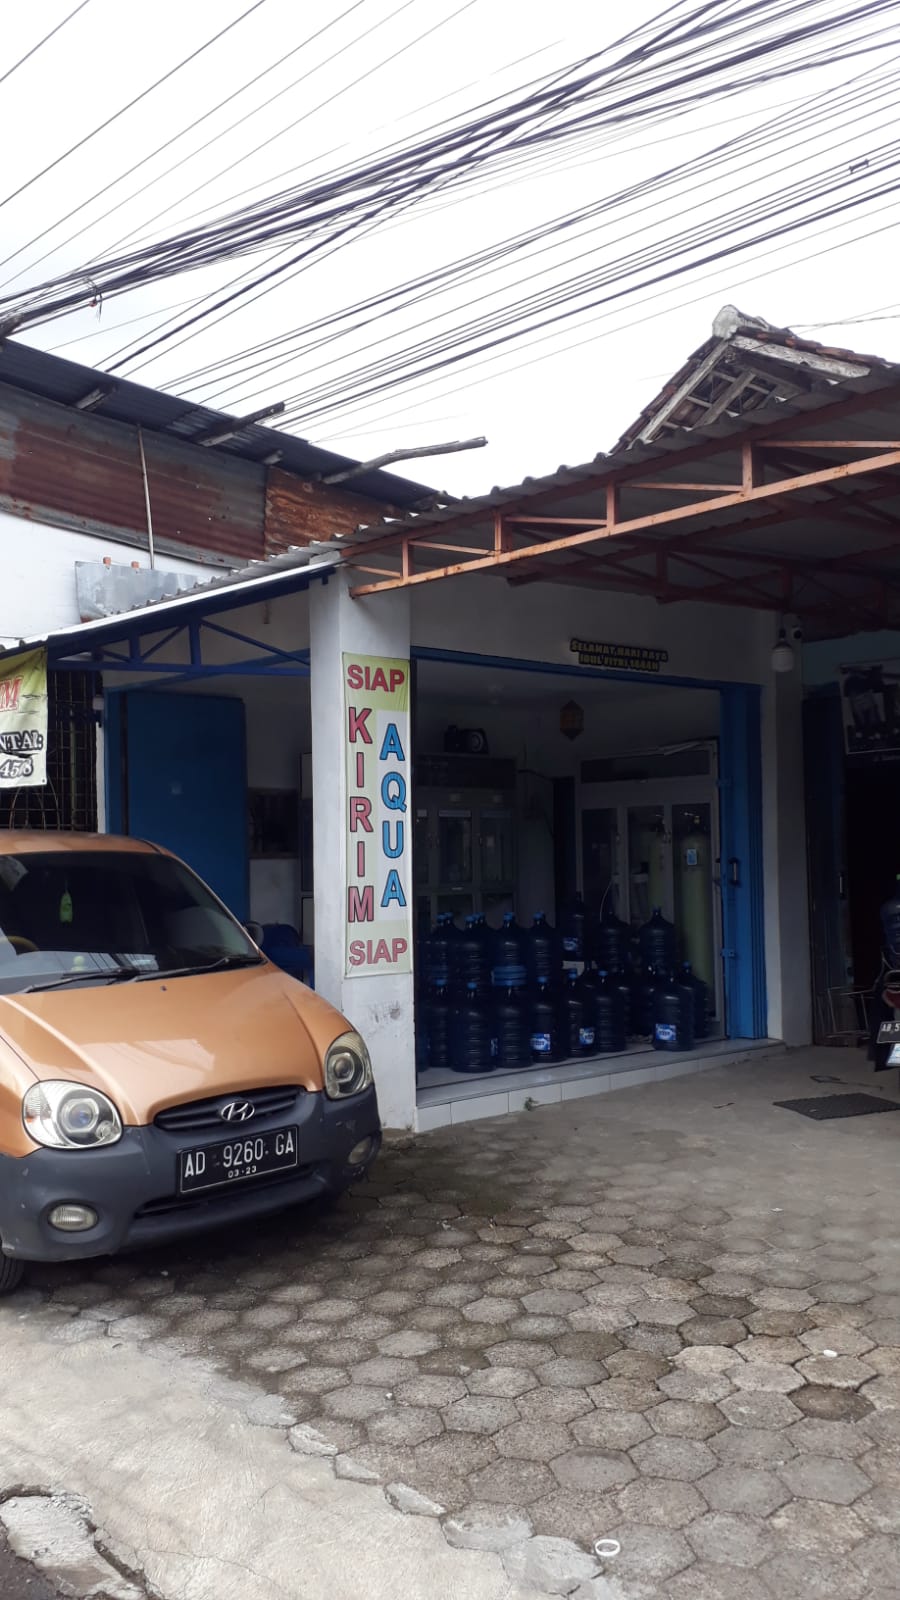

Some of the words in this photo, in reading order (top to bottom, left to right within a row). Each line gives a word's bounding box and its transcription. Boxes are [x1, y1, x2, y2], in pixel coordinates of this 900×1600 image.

[347, 664, 405, 692] SIAP
[348, 706, 374, 923] KIRIM
[379, 723, 407, 907] AQUA
[349, 937, 408, 966] SIAP
[184, 1152, 206, 1178] AD
[223, 1138, 264, 1168] 9260
[275, 1131, 294, 1156] GA
